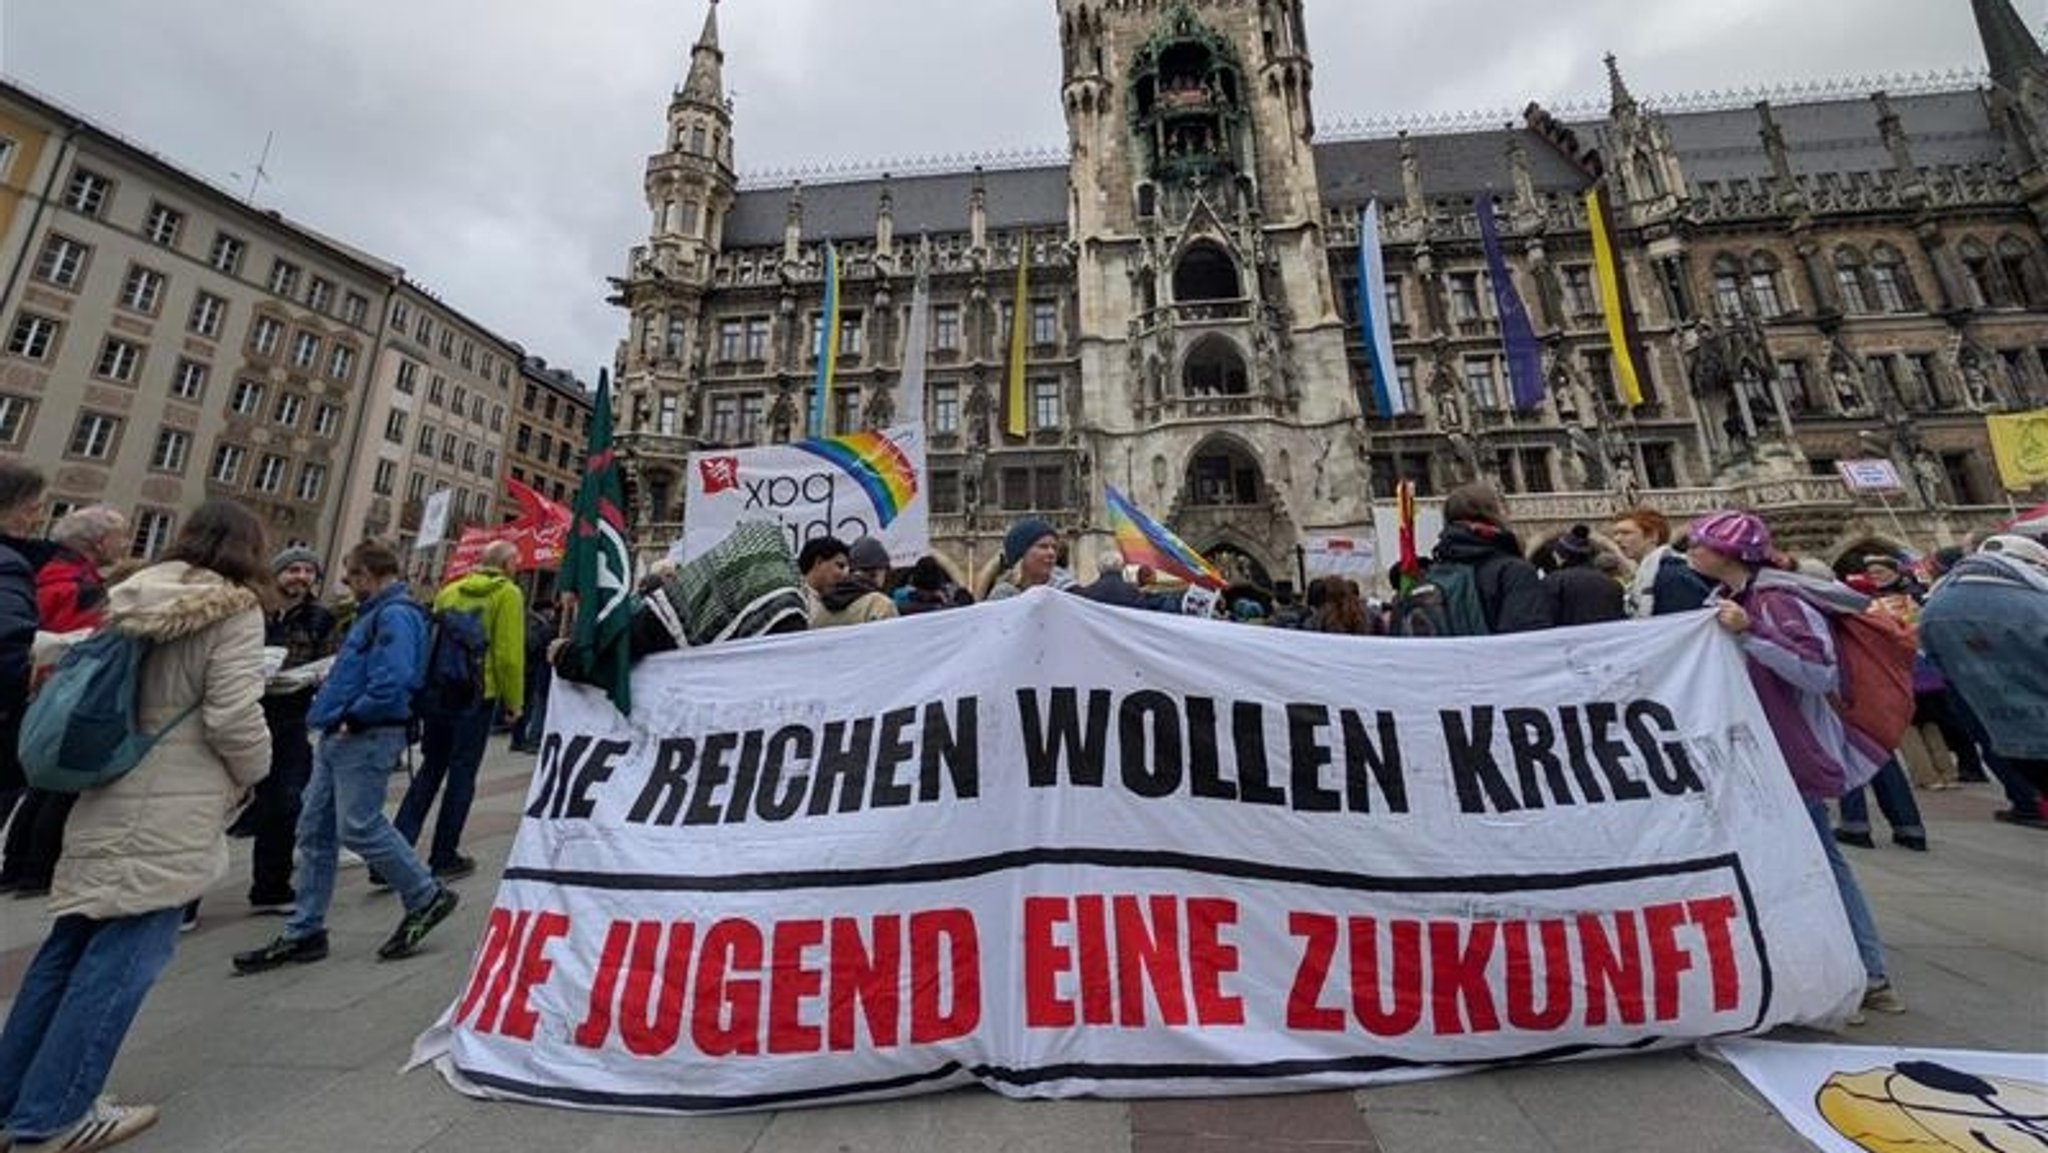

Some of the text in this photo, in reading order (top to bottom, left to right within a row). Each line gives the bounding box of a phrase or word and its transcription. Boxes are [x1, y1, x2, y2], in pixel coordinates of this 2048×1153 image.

[625, 696, 979, 826] REICHEN
[1016, 686, 1409, 814] WOLLEN
[1439, 699, 1706, 814] KRIEG
[575, 908, 982, 1056] JUGEND
[1023, 895, 1244, 1029] EINE
[1286, 896, 1740, 1035] ZUKUNFT
